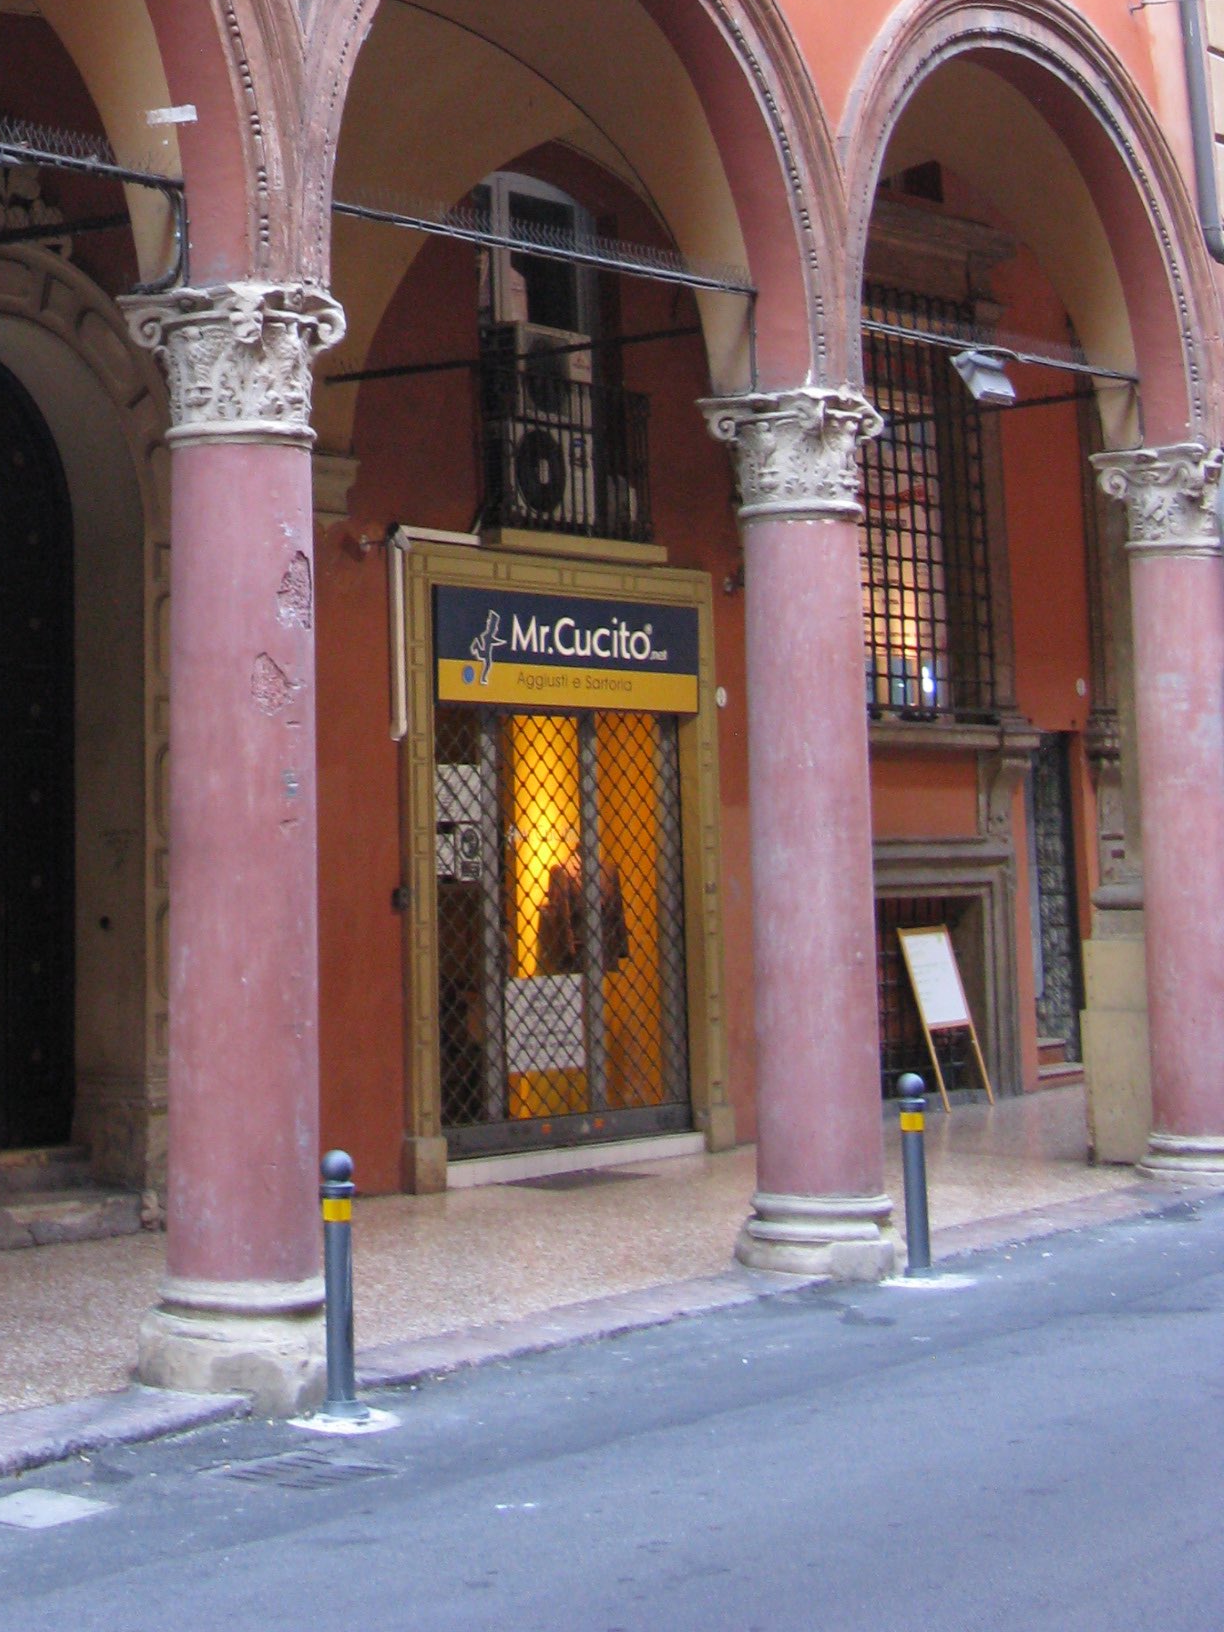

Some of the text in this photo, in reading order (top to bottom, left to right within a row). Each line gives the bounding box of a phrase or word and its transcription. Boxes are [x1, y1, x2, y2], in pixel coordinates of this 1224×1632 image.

[517, 671, 633, 693] Aggiusti e Sartoria
